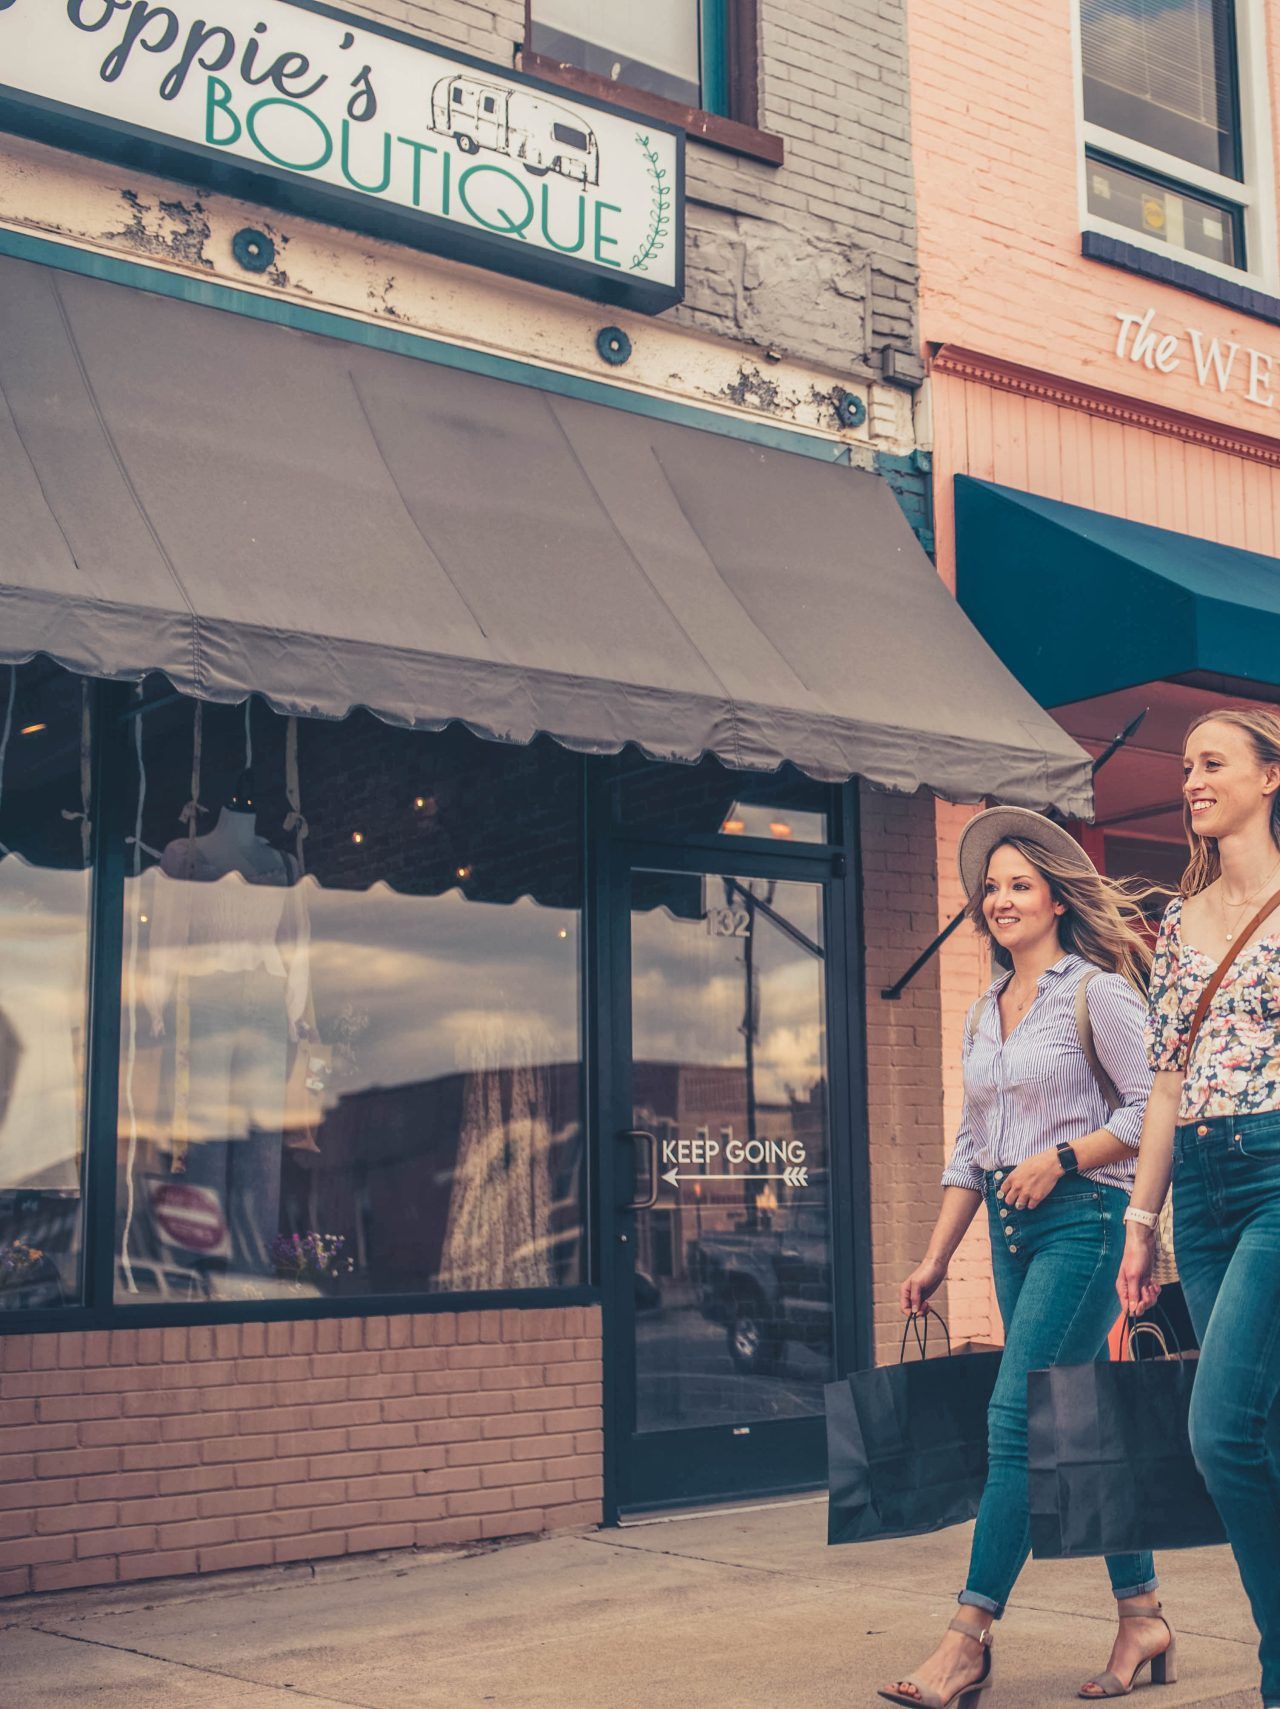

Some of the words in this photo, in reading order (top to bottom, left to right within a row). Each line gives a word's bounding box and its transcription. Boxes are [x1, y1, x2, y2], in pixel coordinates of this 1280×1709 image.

[0, 0, 377, 122] oppie's
[205, 76, 622, 269] BOUTIQUE
[1115, 308, 1181, 374] The
[707, 910, 751, 937] 132
[662, 1140, 719, 1164] KEEP
[725, 1140, 806, 1164] GOING
